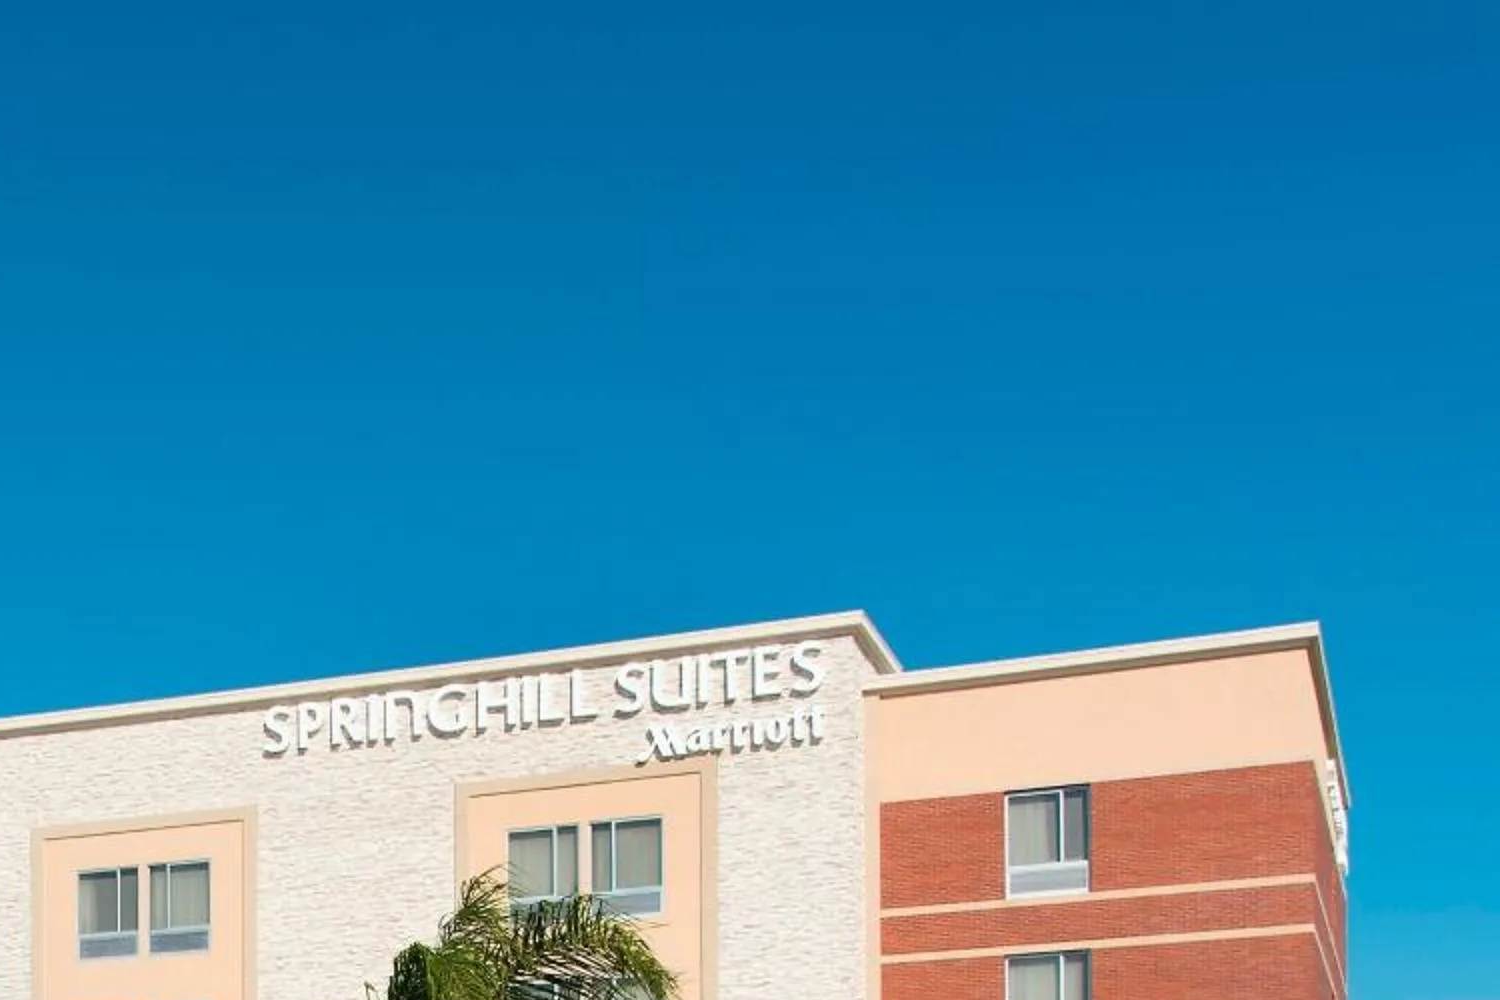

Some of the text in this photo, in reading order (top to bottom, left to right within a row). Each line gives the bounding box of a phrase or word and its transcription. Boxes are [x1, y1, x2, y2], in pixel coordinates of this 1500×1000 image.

[262, 640, 826, 757] SPRINGHILL SUITES
[636, 705, 825, 765] Marriott
